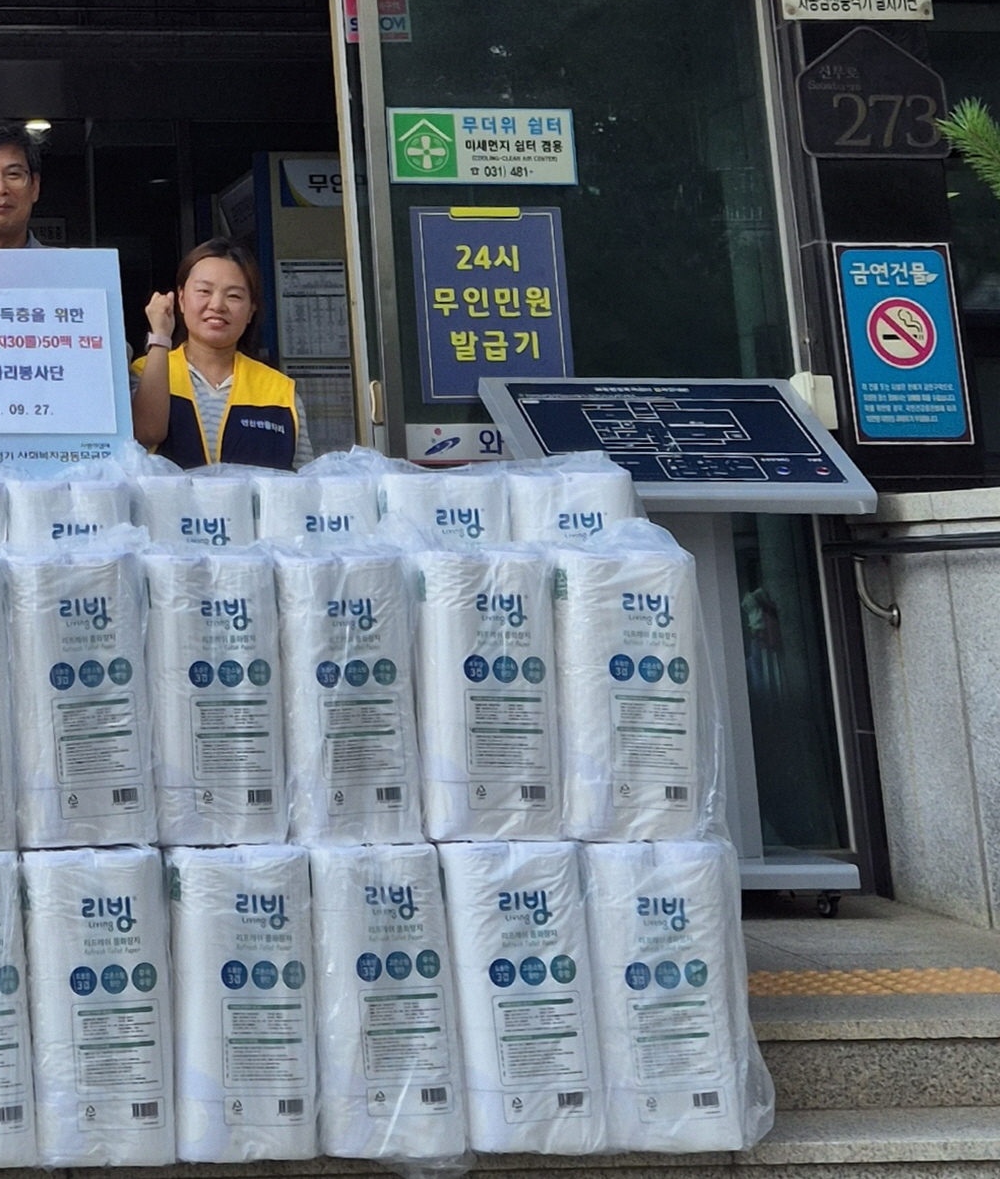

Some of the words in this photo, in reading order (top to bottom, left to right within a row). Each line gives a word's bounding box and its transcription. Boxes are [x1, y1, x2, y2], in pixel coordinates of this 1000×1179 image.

[462, 116, 516, 135] 무더위
[527, 116, 562, 135] 쉼터
[832, 93, 942, 148] 273
[465, 139, 510, 152] 미세먼지
[515, 140, 537, 152] 쉼터
[541, 140, 563, 153] 겸용
[484, 166, 506, 178] 031)
[510, 166, 534, 177] 481-
[455, 245, 520, 272] 24시
[850, 262, 930, 286] 금연건물
[55, 307, 84, 323] 위한
[432, 287, 553, 318] 무인민원
[78, 335, 104, 349] 전달
[450, 331, 541, 362] 발급기
[9, 404, 29, 415] 09.
[34, 404, 54, 415] 27.
[436, 508, 484, 539] 리빙
[60, 596, 112, 630] 리빙
[201, 598, 252, 631] 리빙
[327, 598, 378, 631] 리빙
[476, 594, 528, 627] 리빙
[622, 593, 674, 628] 리빙
[82, 896, 137, 933] 리빙
[236, 894, 289, 930] 리빙
[365, 886, 419, 920] 리빙
[499, 891, 552, 925] 리빙
[637, 897, 689, 932] 리빙
[88, 921, 113, 931] Living
[242, 917, 266, 928] Living
[505, 914, 529, 925] Living
[644, 920, 668, 930] Living
